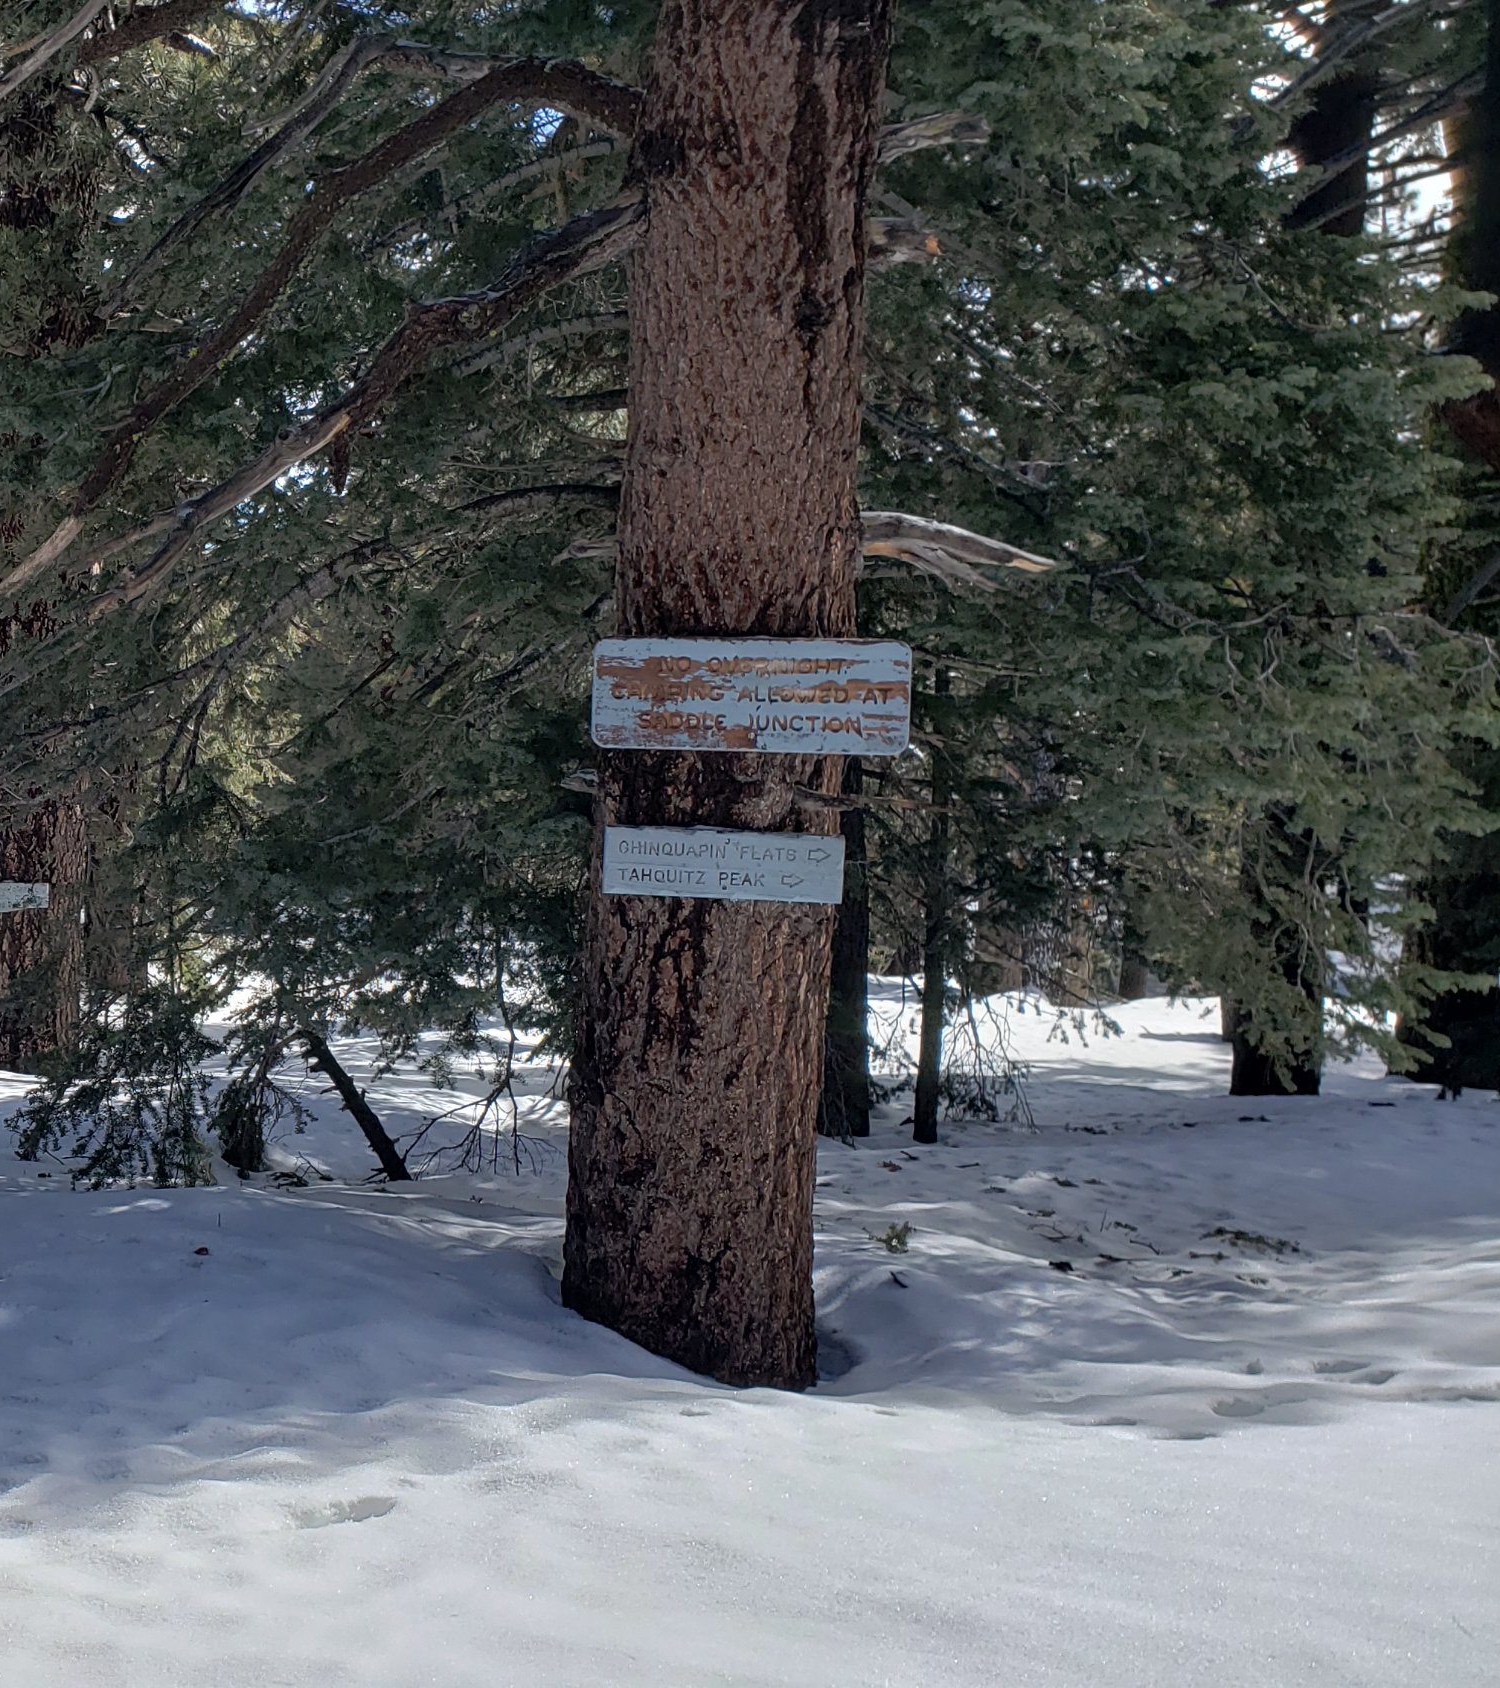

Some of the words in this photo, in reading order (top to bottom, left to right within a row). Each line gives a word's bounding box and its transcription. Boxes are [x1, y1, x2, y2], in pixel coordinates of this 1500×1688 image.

[659, 656, 692, 674] NO
[862, 687, 894, 705] AT
[637, 711, 728, 731] SADDLE
[748, 714, 863, 737] JUNCTION
[739, 845, 797, 862] FLATS
[617, 867, 706, 885] TAHQUITZ
[718, 871, 765, 887] PEAK
